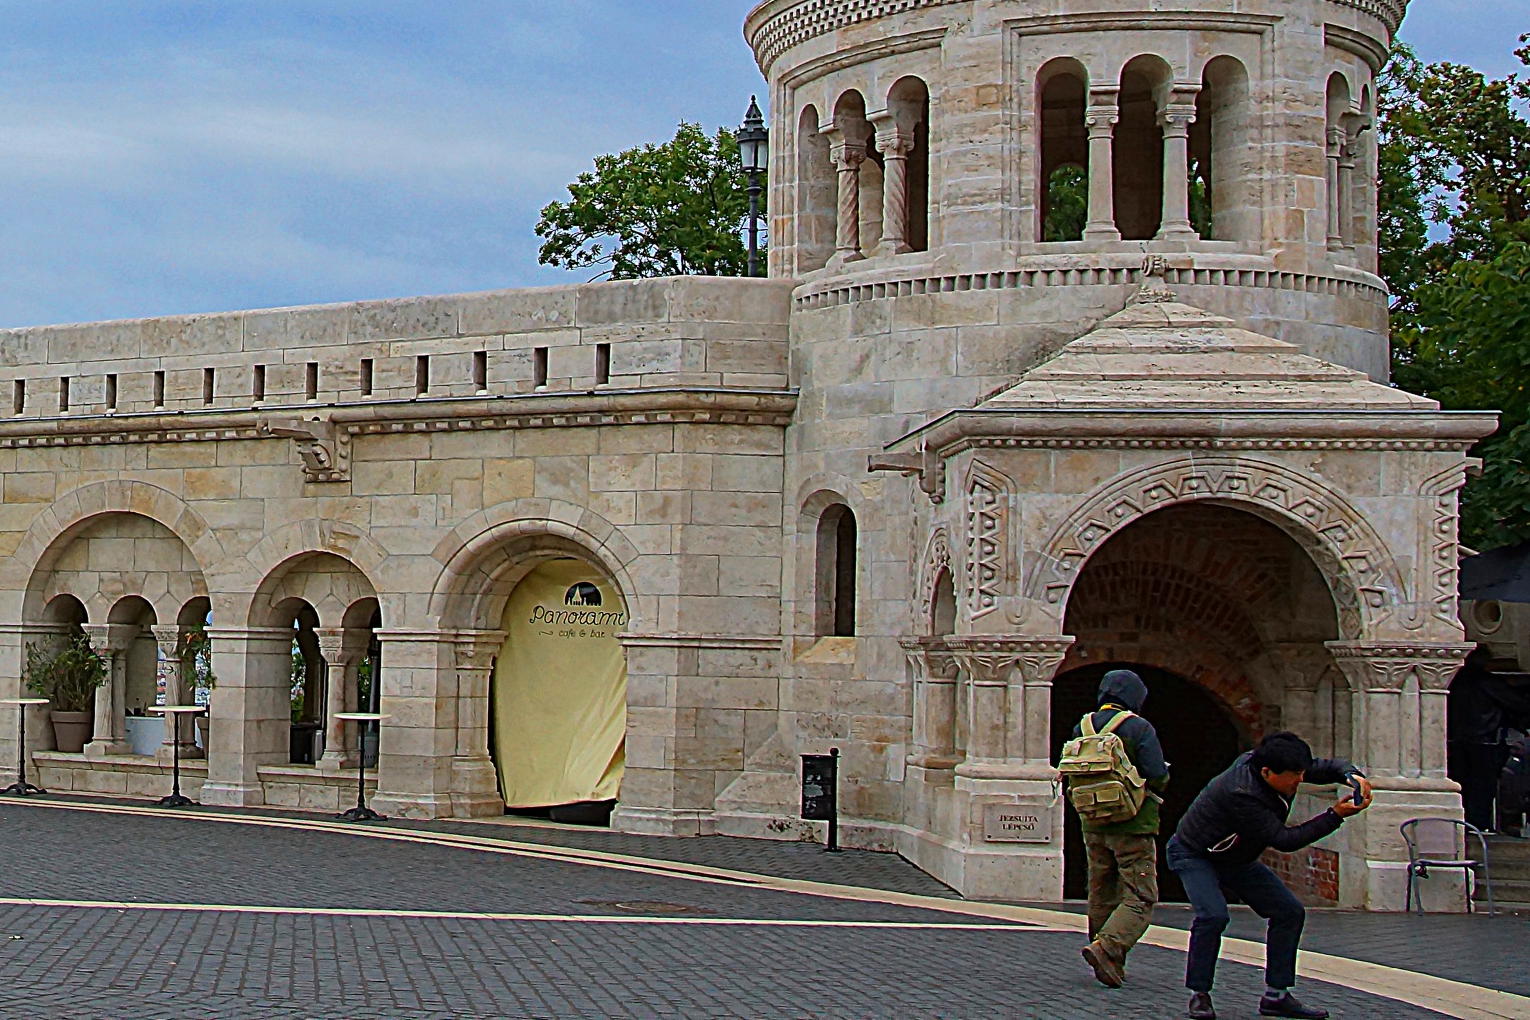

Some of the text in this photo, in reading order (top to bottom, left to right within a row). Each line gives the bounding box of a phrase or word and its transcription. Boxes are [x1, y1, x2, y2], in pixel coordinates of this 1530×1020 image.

[558, 629, 576, 638] cafe
[590, 629, 605, 638] bar
[998, 814, 1039, 822] JEZSUITA
